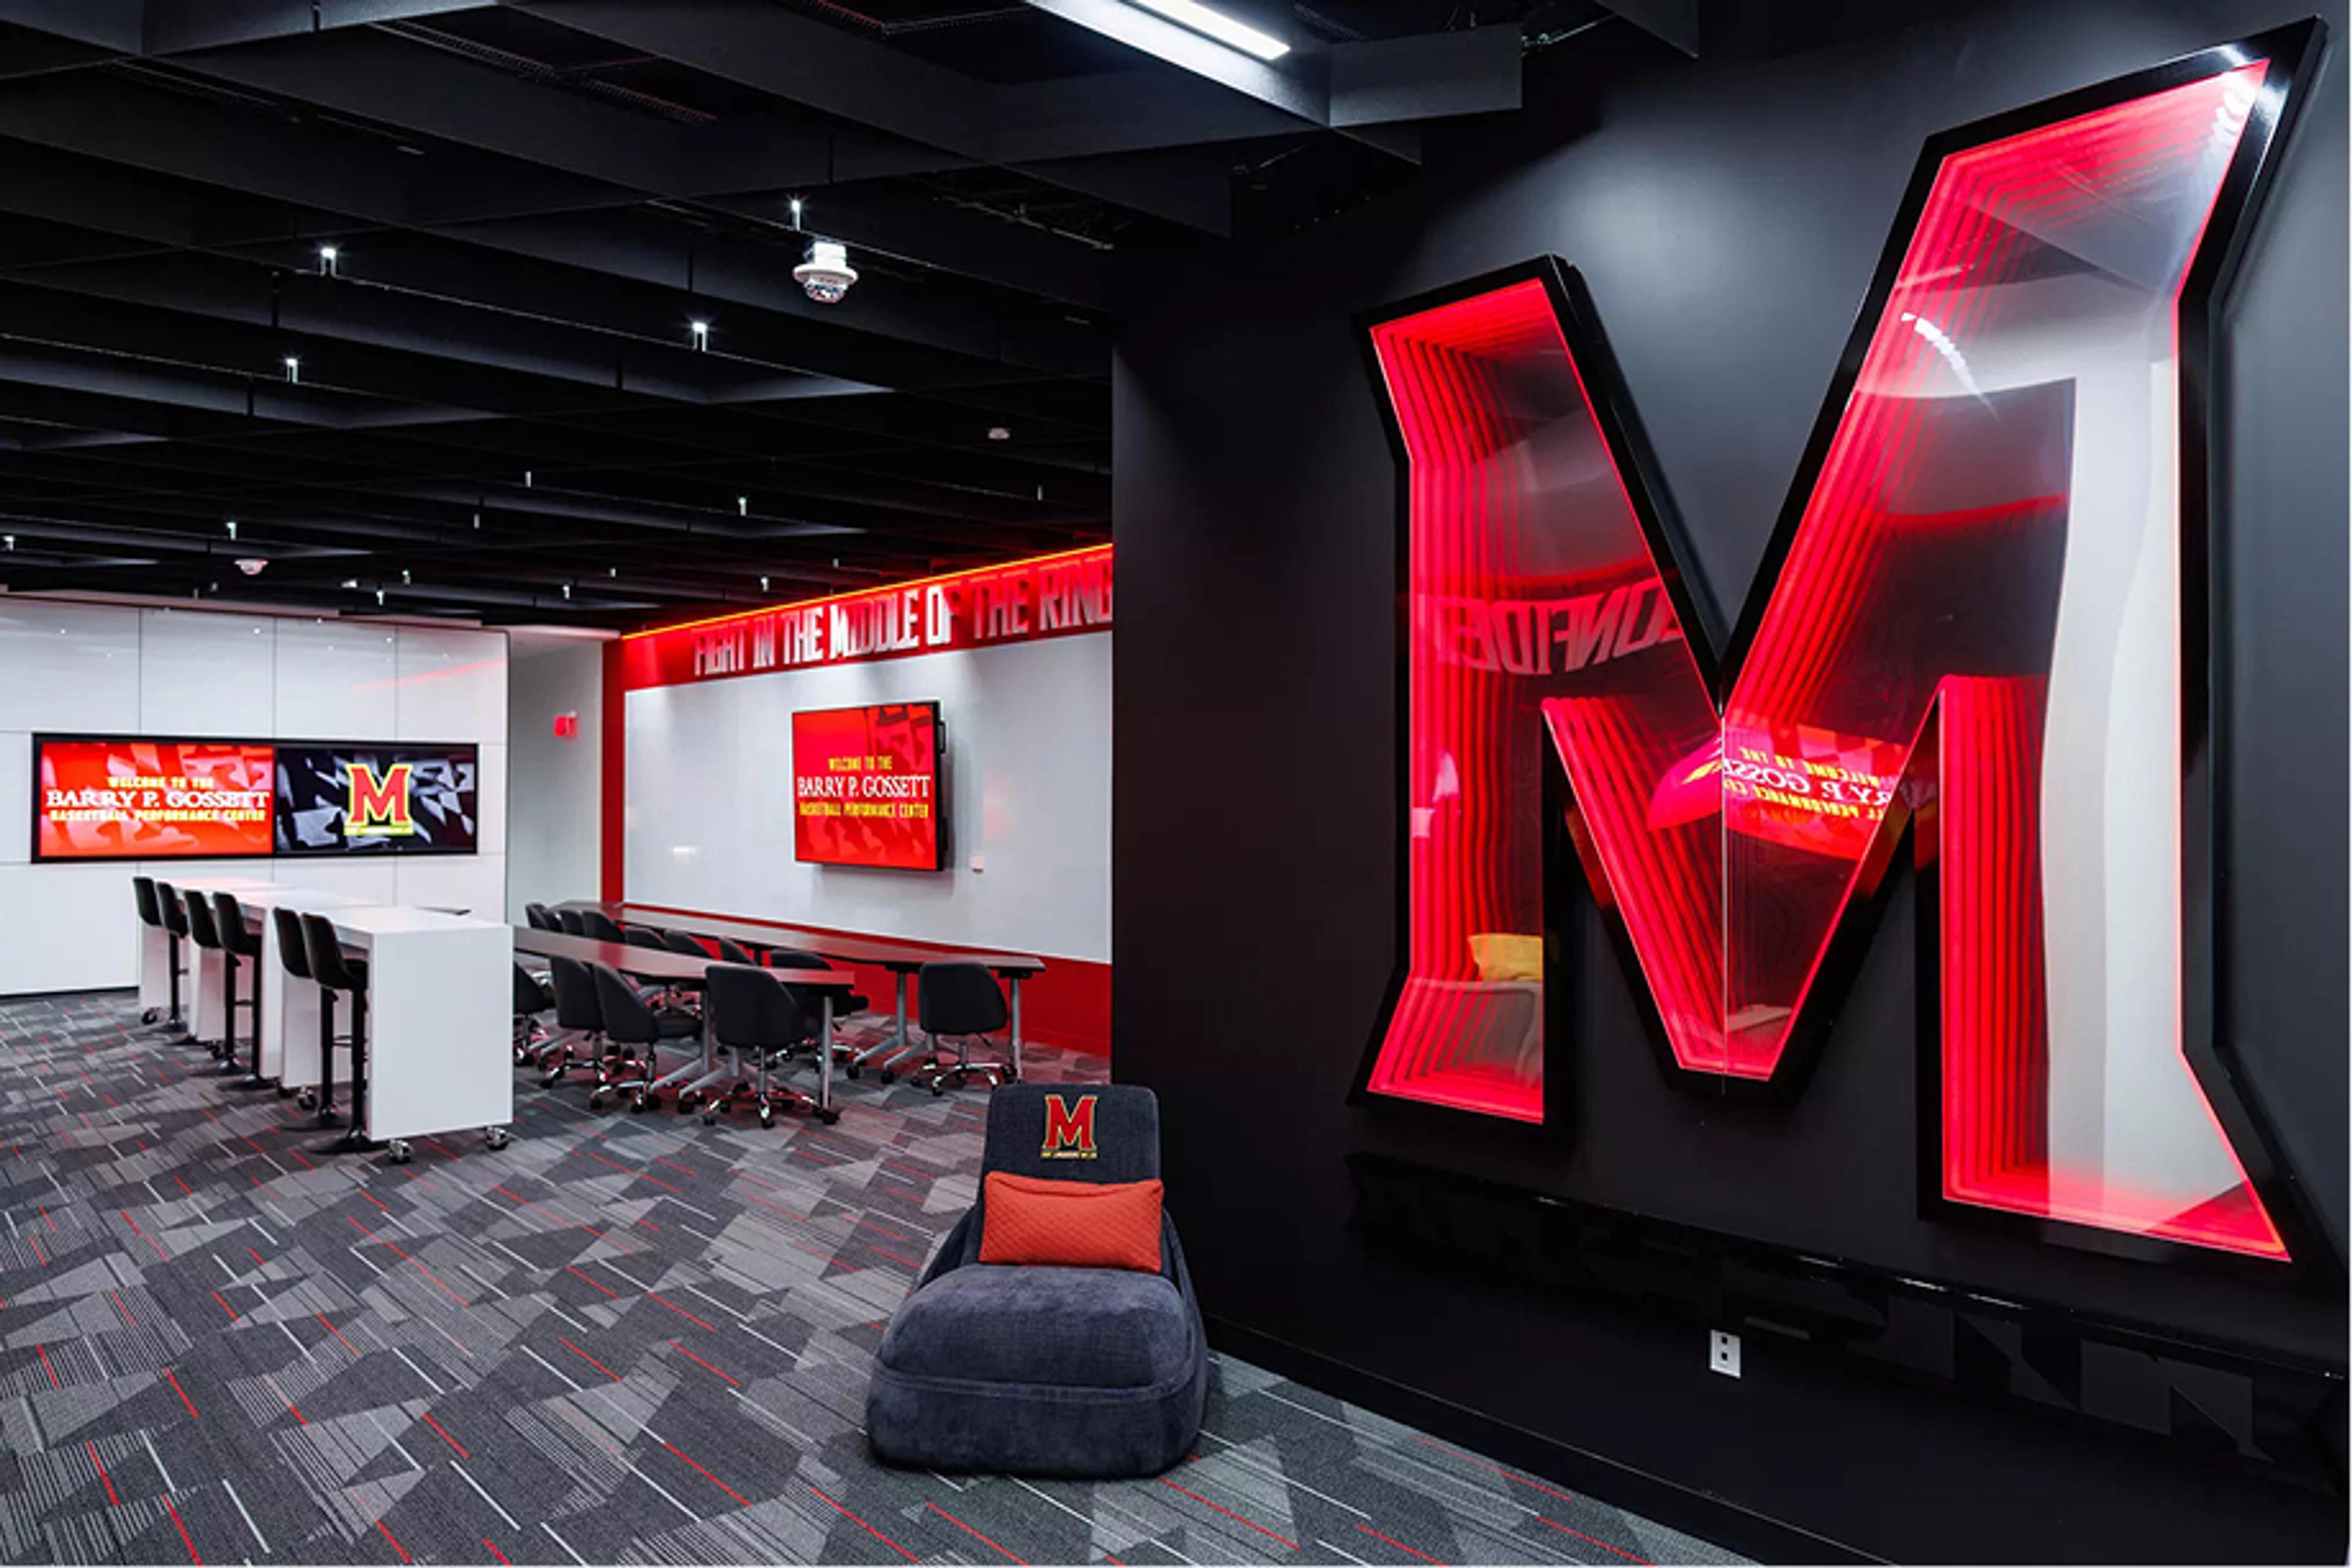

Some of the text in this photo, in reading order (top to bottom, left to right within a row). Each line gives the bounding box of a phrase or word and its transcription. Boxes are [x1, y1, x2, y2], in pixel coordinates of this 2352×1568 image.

[692, 620, 748, 676] FIGHT
[753, 614, 775, 668] IN
[782, 607, 823, 664] THE
[829, 588, 919, 659] MIDDLE
[925, 581, 960, 646] OF
[970, 570, 1029, 639] THE
[1352, 16, 2328, 1265] M
[46, 790, 270, 808] BARRY P. GOSSETT
[345, 763, 413, 826] M
[797, 775, 930, 797] BARRY P. GOSSETT
[1042, 1094, 1098, 1150] M
